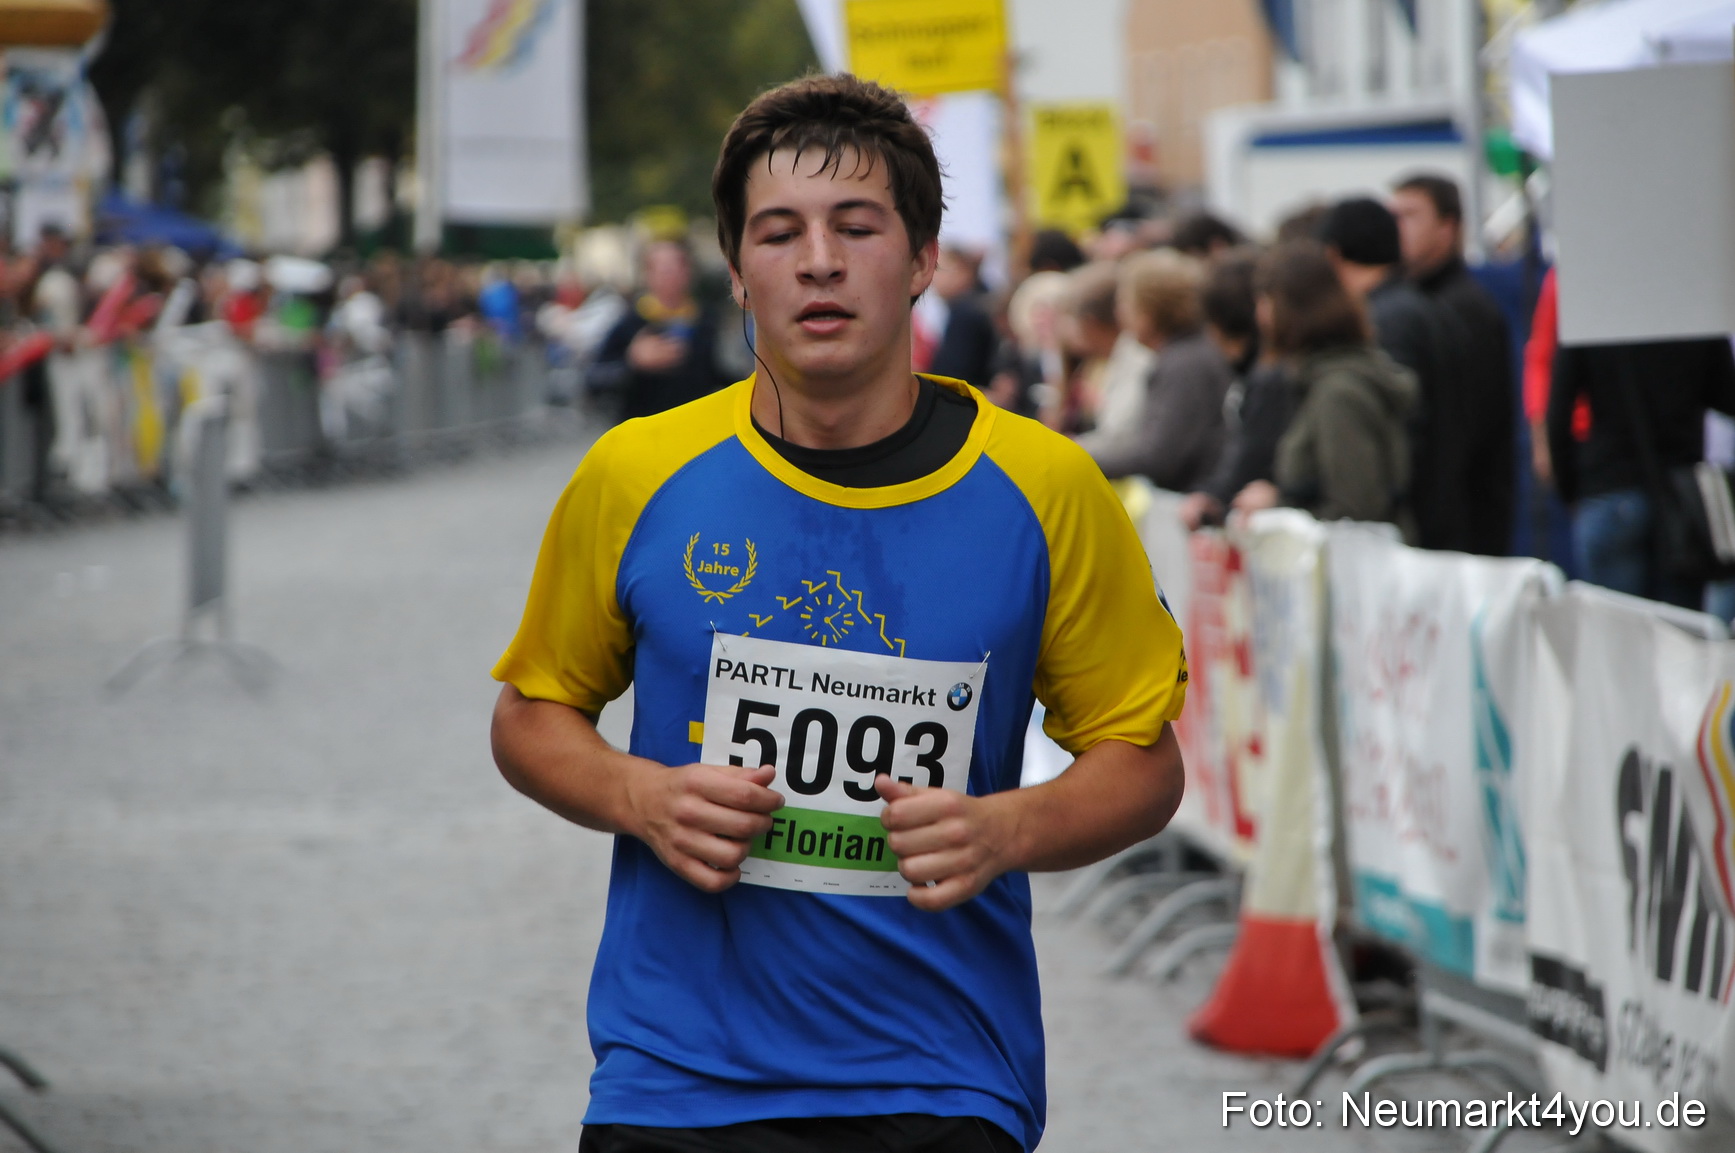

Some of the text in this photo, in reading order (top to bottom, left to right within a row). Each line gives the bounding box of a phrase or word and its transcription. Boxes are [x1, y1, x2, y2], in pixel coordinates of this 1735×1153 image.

[697, 560, 740, 577] Jahre
[713, 543, 730, 556] 15
[715, 657, 937, 706] PARTL Neumarkt
[729, 698, 949, 802] 5093
[764, 817, 886, 862] Florian
